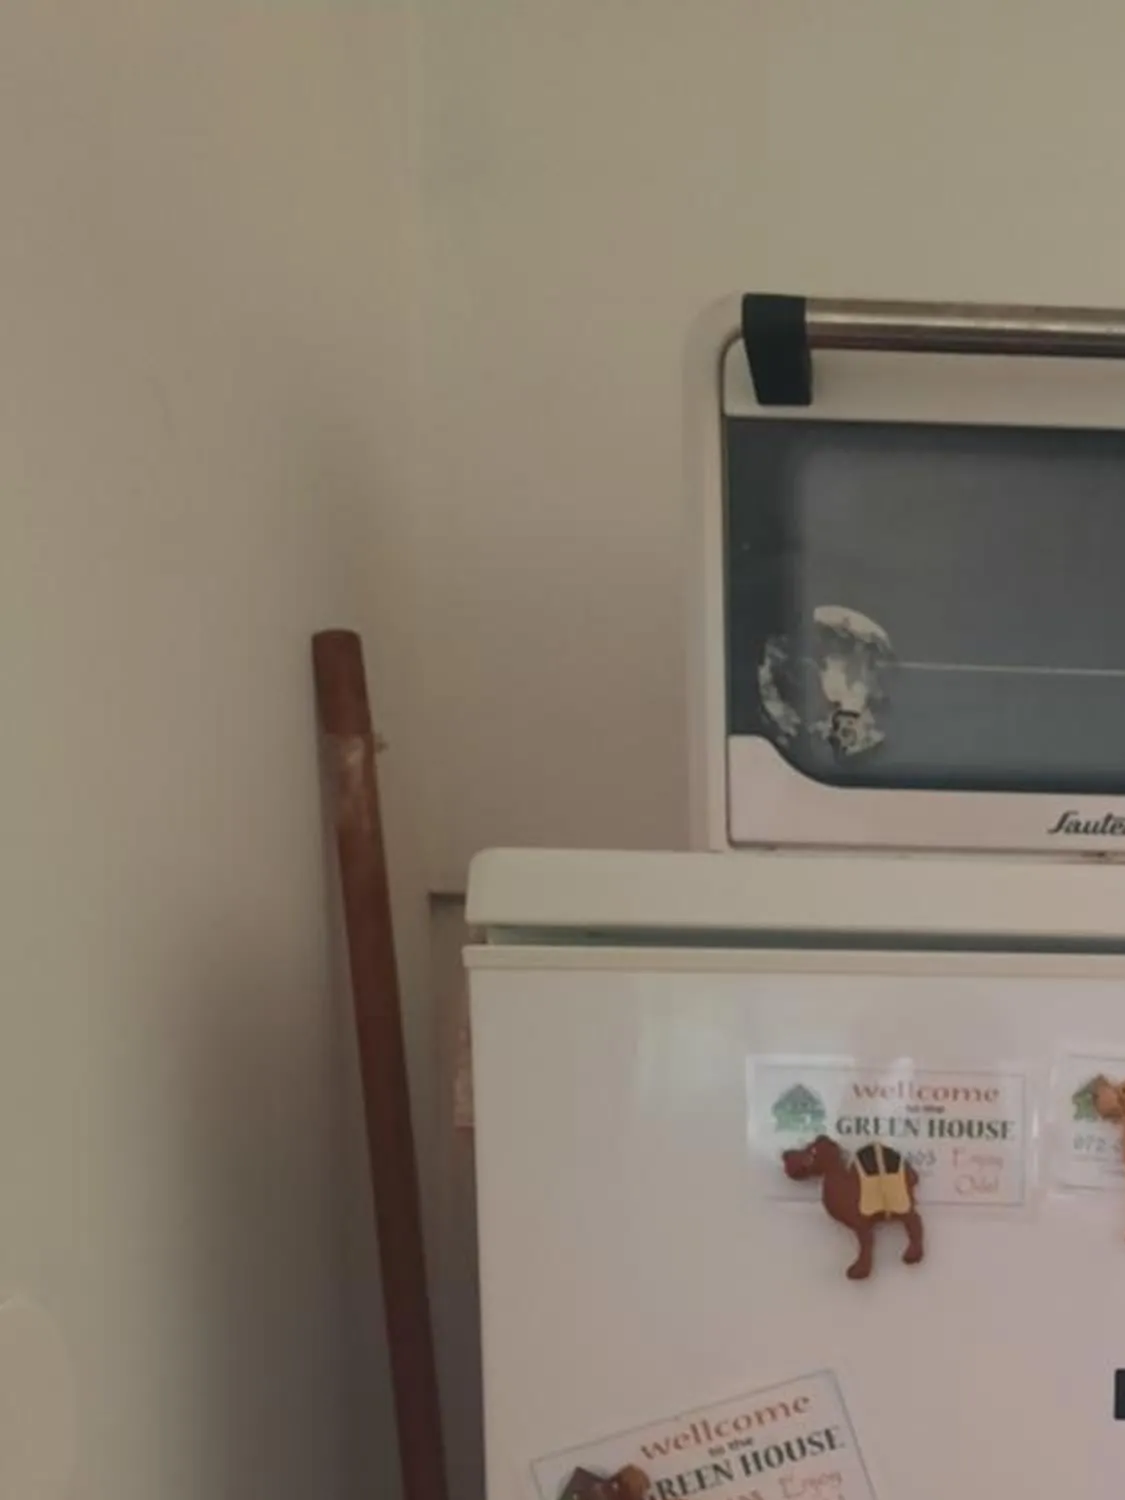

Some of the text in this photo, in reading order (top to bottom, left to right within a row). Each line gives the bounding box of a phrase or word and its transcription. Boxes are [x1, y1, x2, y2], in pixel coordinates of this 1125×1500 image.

[853, 1081, 1000, 1103] wellcome
[836, 1114, 1014, 1141] GREEN HOUSE
[639, 1395, 811, 1460] wellcome
[739, 1426, 848, 1478] HOUSE
